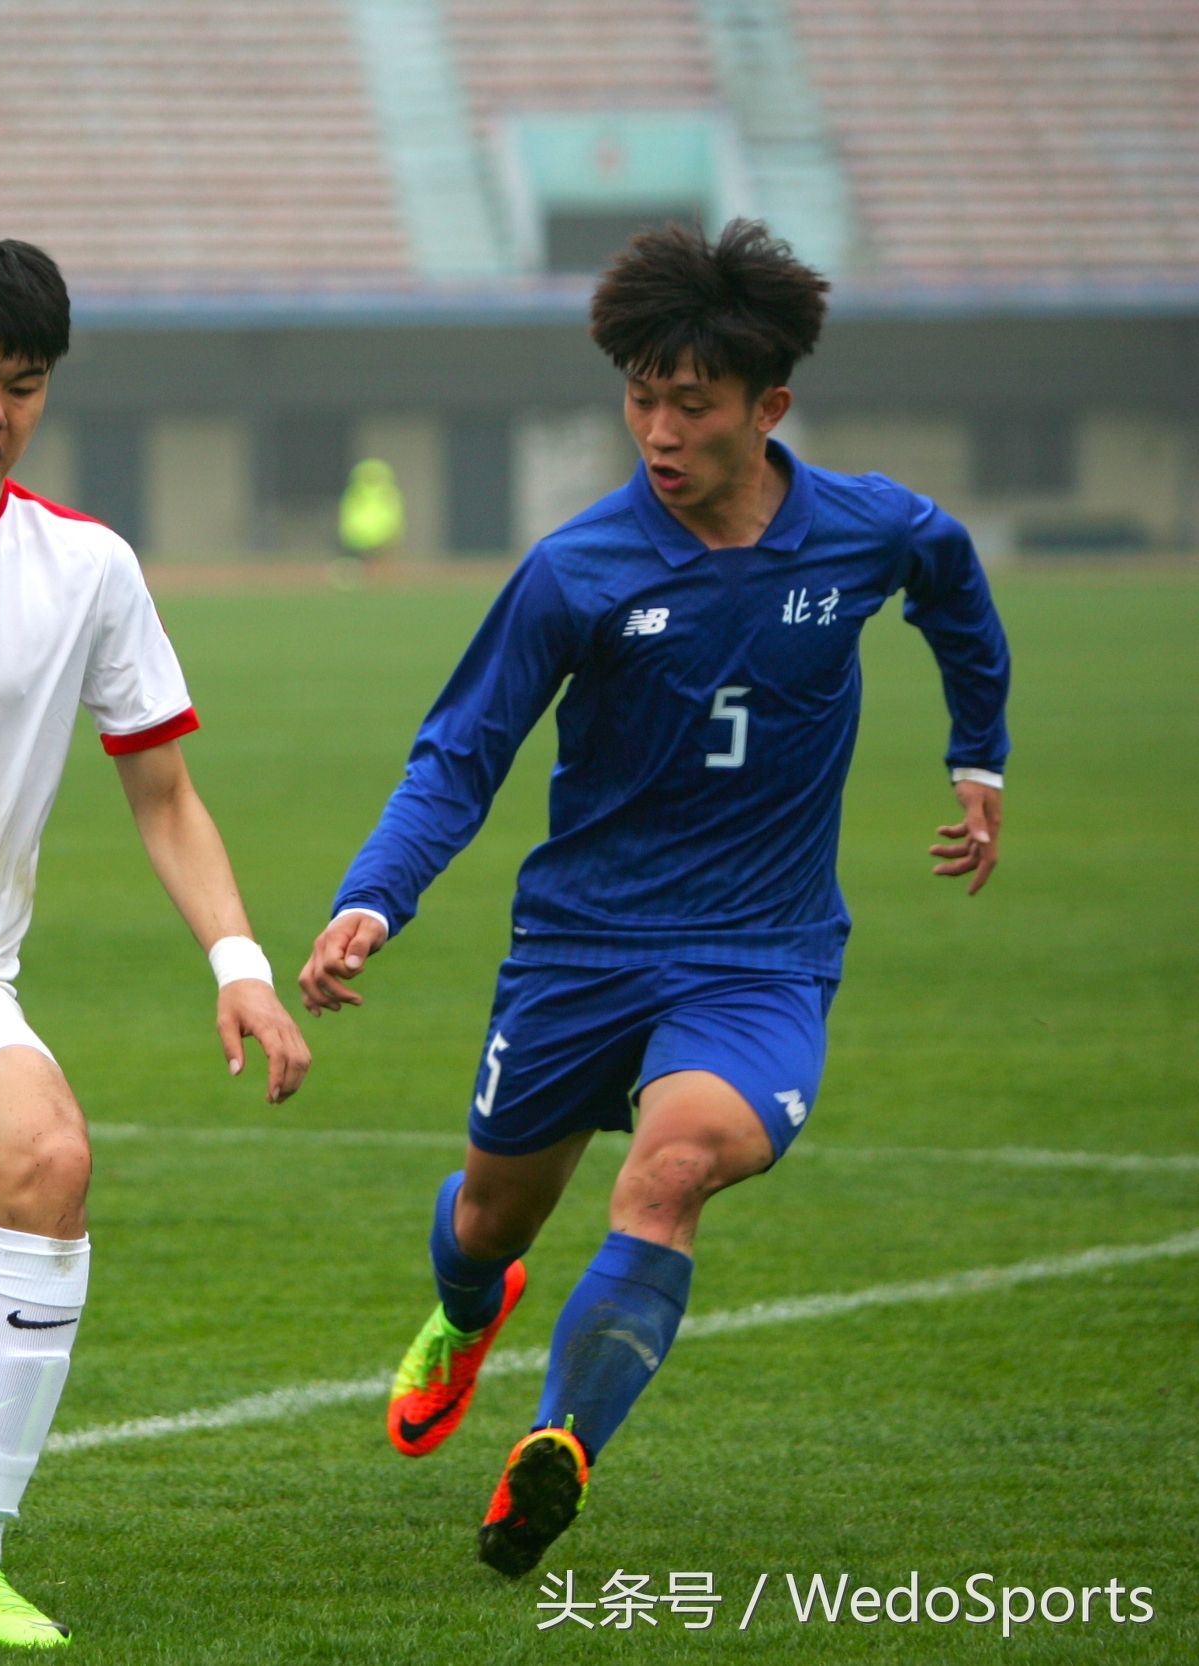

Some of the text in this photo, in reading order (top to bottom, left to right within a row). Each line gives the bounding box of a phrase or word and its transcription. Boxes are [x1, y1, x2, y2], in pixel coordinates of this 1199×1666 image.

[782, 587, 840, 626] 北京
[704, 686, 752, 768] 5
[475, 1031, 510, 1118] 5
